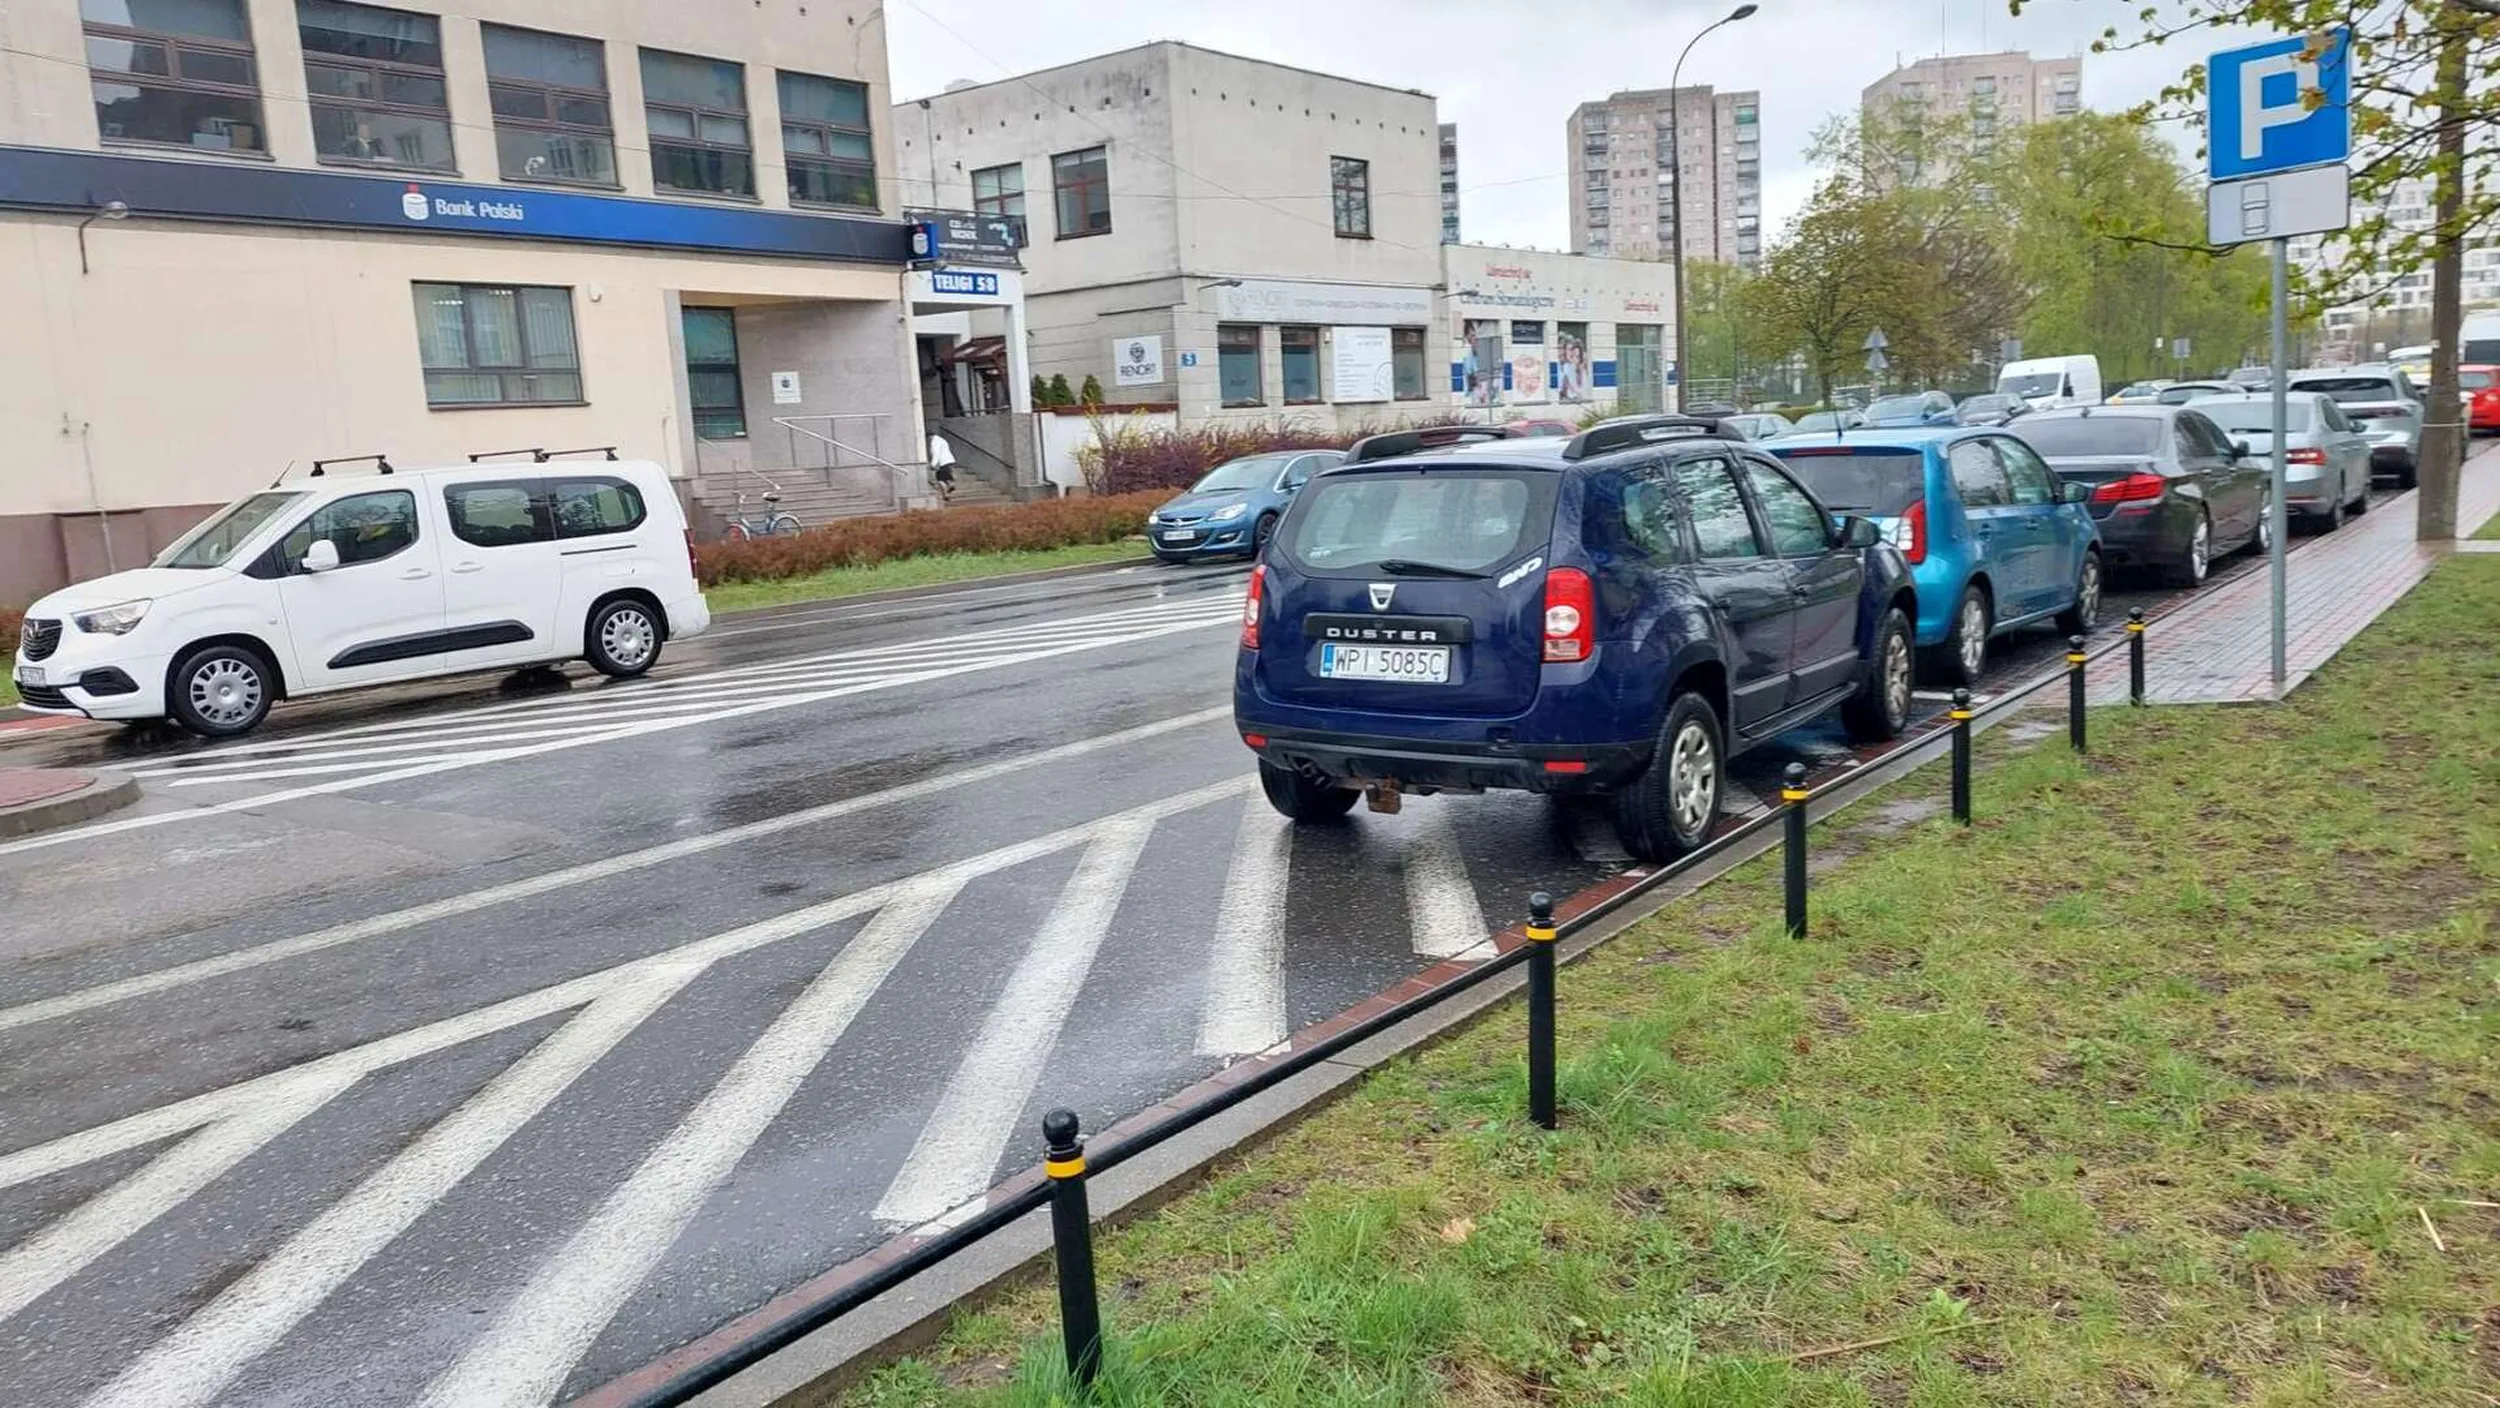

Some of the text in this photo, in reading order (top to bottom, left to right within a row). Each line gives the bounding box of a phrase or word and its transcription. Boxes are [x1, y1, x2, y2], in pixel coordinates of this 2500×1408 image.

[2240, 51, 2320, 160] P
[434, 198, 524, 221] Bank Polski
[934, 274, 973, 292] TELIGI
[1325, 627, 1437, 641] DUSTER
[1335, 649, 1442, 675] WPI 5085C
